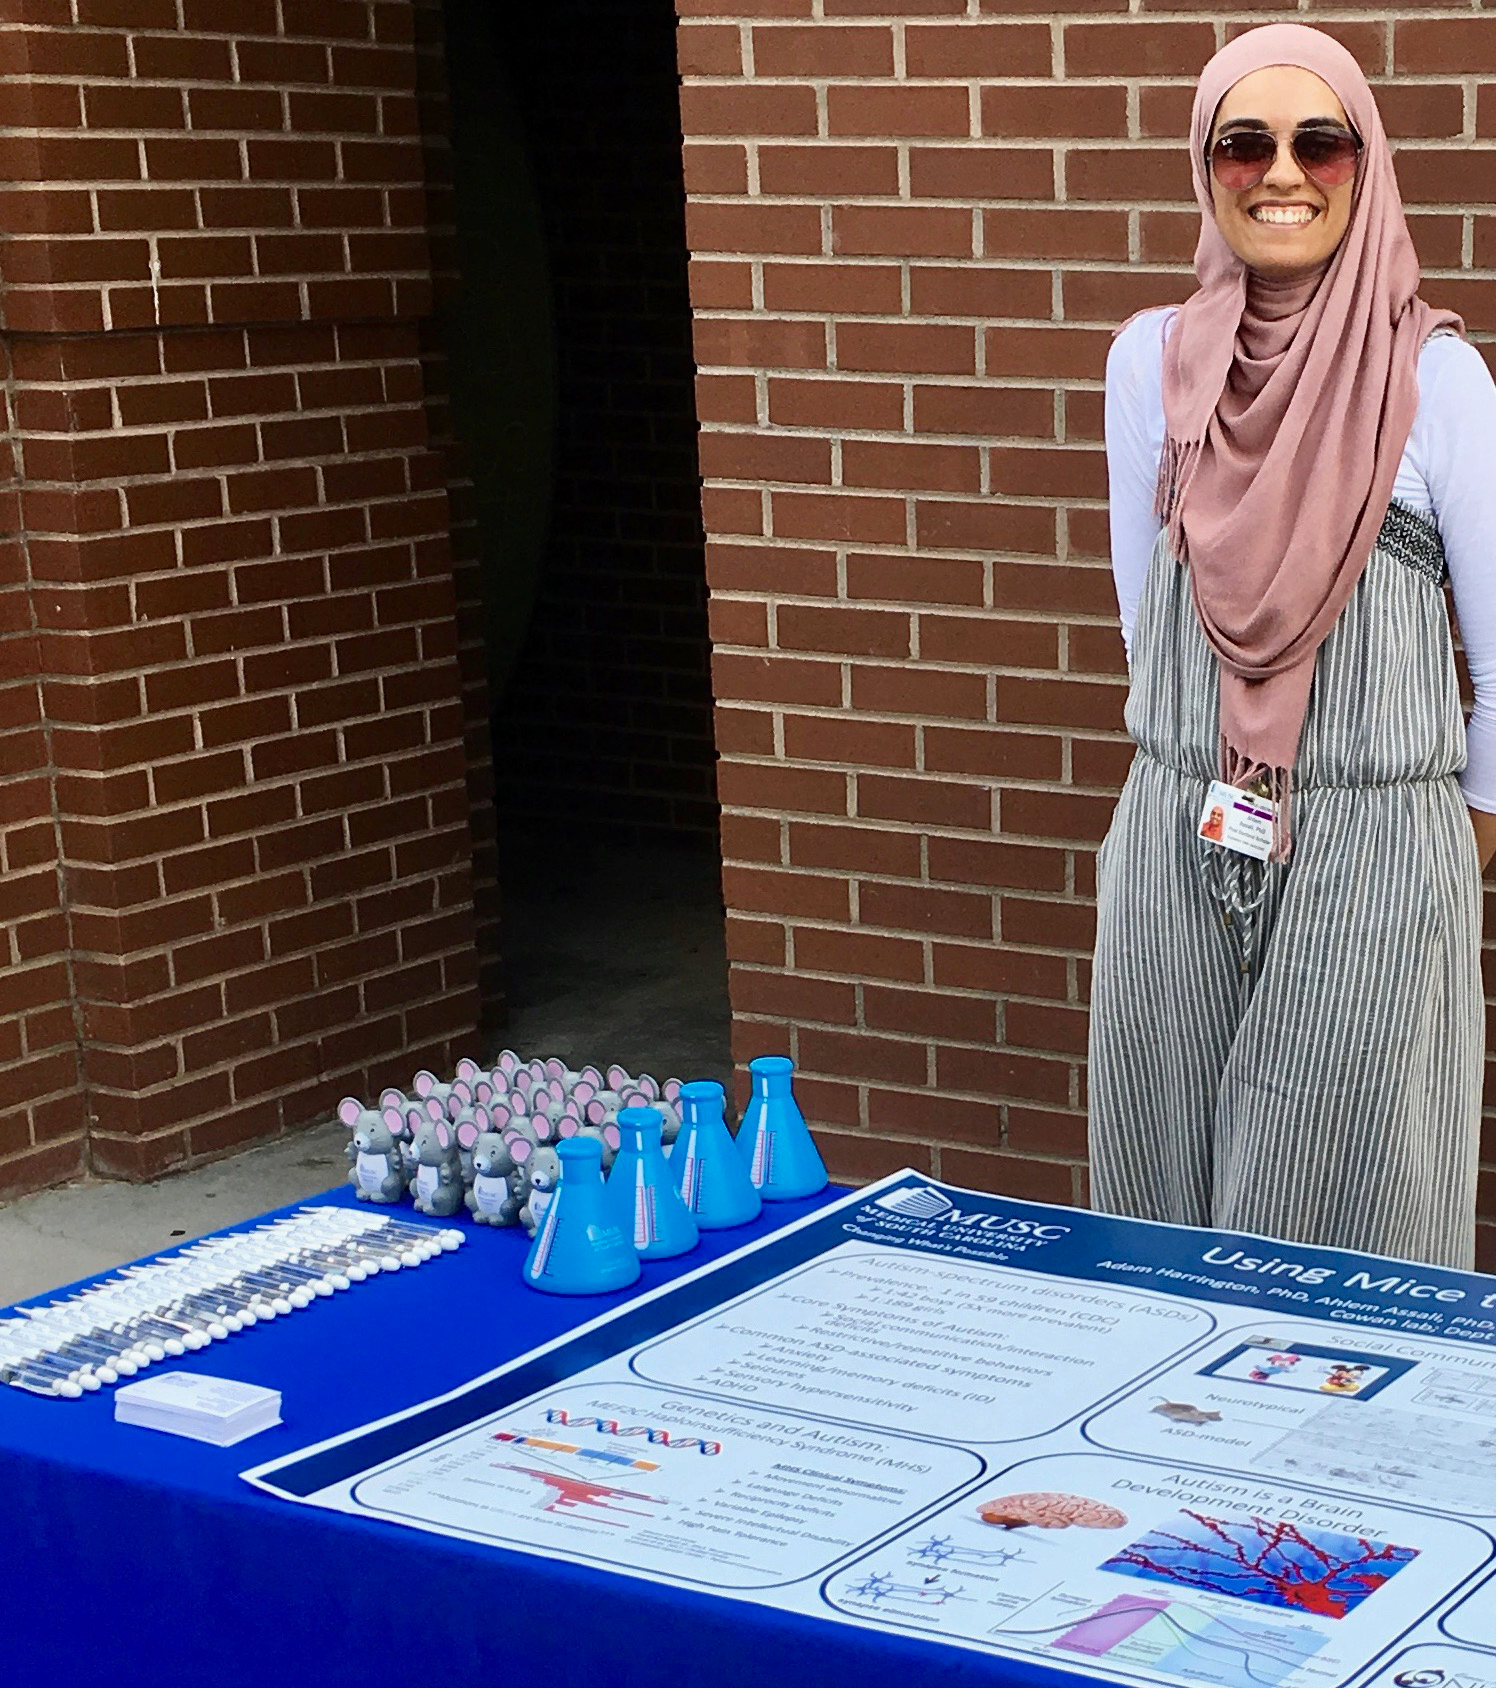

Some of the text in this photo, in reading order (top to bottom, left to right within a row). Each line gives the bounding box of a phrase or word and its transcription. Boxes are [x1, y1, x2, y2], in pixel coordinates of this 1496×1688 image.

[842, 1223, 905, 1244] Changing
[908, 1237, 953, 1252] What's
[860, 1205, 1048, 1247] MEDICAL UNIVERSITY
[873, 1219, 936, 1237] SOUTH
[939, 1231, 1027, 1252] CAROLINA
[937, 1208, 1071, 1240] MUSC
[860, 1258, 1199, 1323] Autism-spectrum disorders (ASDs)
[1096, 1260, 1152, 1274] Adam
[1156, 1267, 1261, 1295] Harrington,
[1266, 1287, 1310, 1303] PhD,
[1314, 1296, 1380, 1312] Ahlem
[1382, 1305, 1444, 1324] Assali,
[1450, 1316, 1495, 1331] PhD,
[1201, 1246, 1337, 1285] Using
[1342, 1271, 1466, 1303] Mice
[791, 1296, 1010, 1340] Core Symptoms of Autism:
[841, 1270, 930, 1291] Prevalence:
[955, 1291, 971, 1299] in
[975, 1294, 998, 1302] 59
[998, 1299, 1067, 1316] children
[1069, 1311, 1120, 1326] (CDC)
[910, 1303, 947, 1316] girls
[919, 1293, 955, 1307] boys
[986, 1306, 1027, 1319] more
[1028, 1314, 1112, 1335] prevalent)
[824, 1320, 884, 1334] deficits
[835, 1314, 1095, 1367] Social communication/interaction
[1328, 1335, 1399, 1352] Social
[1329, 1309, 1397, 1327] Cowan
[1401, 1319, 1440, 1334] lab;
[1443, 1326, 1494, 1342] Dept
[729, 1325, 1034, 1388] Common ASD-associated symptoms
[740, 1362, 806, 1379] Seizures
[771, 1345, 834, 1363] Anxiety
[809, 1326, 1054, 1376] Restrictive/repetitive behaviors
[707, 1378, 759, 1392] ADHD
[724, 1370, 919, 1413] Sensory hypersensitivity
[756, 1353, 997, 1404] Learning/memory deficits (ID)
[1205, 1393, 1305, 1415] Neurotypical
[645, 1410, 790, 1446] Haploinsufficiency
[790, 1440, 876, 1462] Syndrome
[875, 1457, 932, 1474] (MHS)
[661, 1400, 890, 1452] Genetics and Autism:
[1160, 1427, 1253, 1449] ASD-model
[1110, 1478, 1389, 1538] Development Disorder
[1161, 1474, 1363, 1520] Autism is a Brain
[734, 1518, 800, 1536] Intellectual
